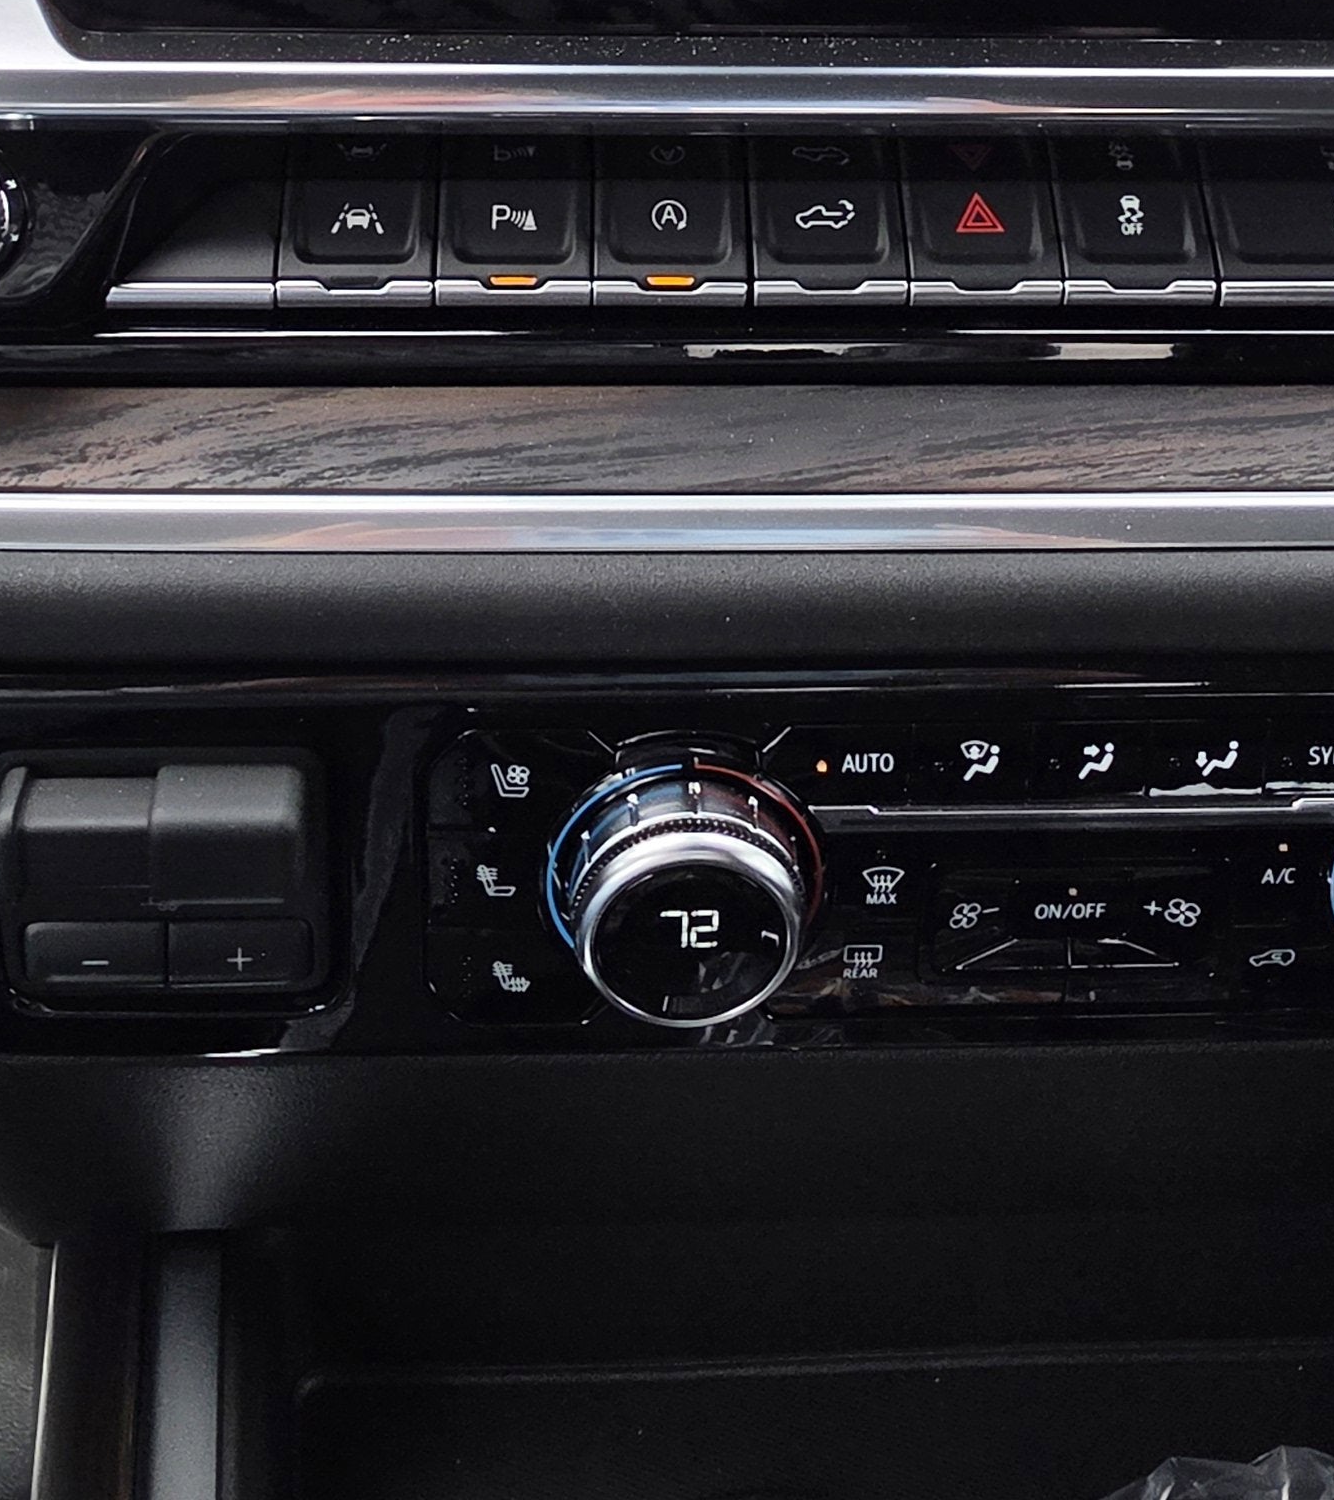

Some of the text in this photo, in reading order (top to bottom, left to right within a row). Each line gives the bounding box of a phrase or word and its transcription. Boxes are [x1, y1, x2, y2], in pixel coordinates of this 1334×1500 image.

[1121, 222, 1144, 235] OFF
[842, 753, 895, 773] AUTO
[1261, 868, 1296, 886] A/C
[866, 893, 898, 905] MAX
[1034, 902, 1107, 922] ON/OFF
[659, 909, 719, 948] 72
[843, 968, 878, 979] REAR
